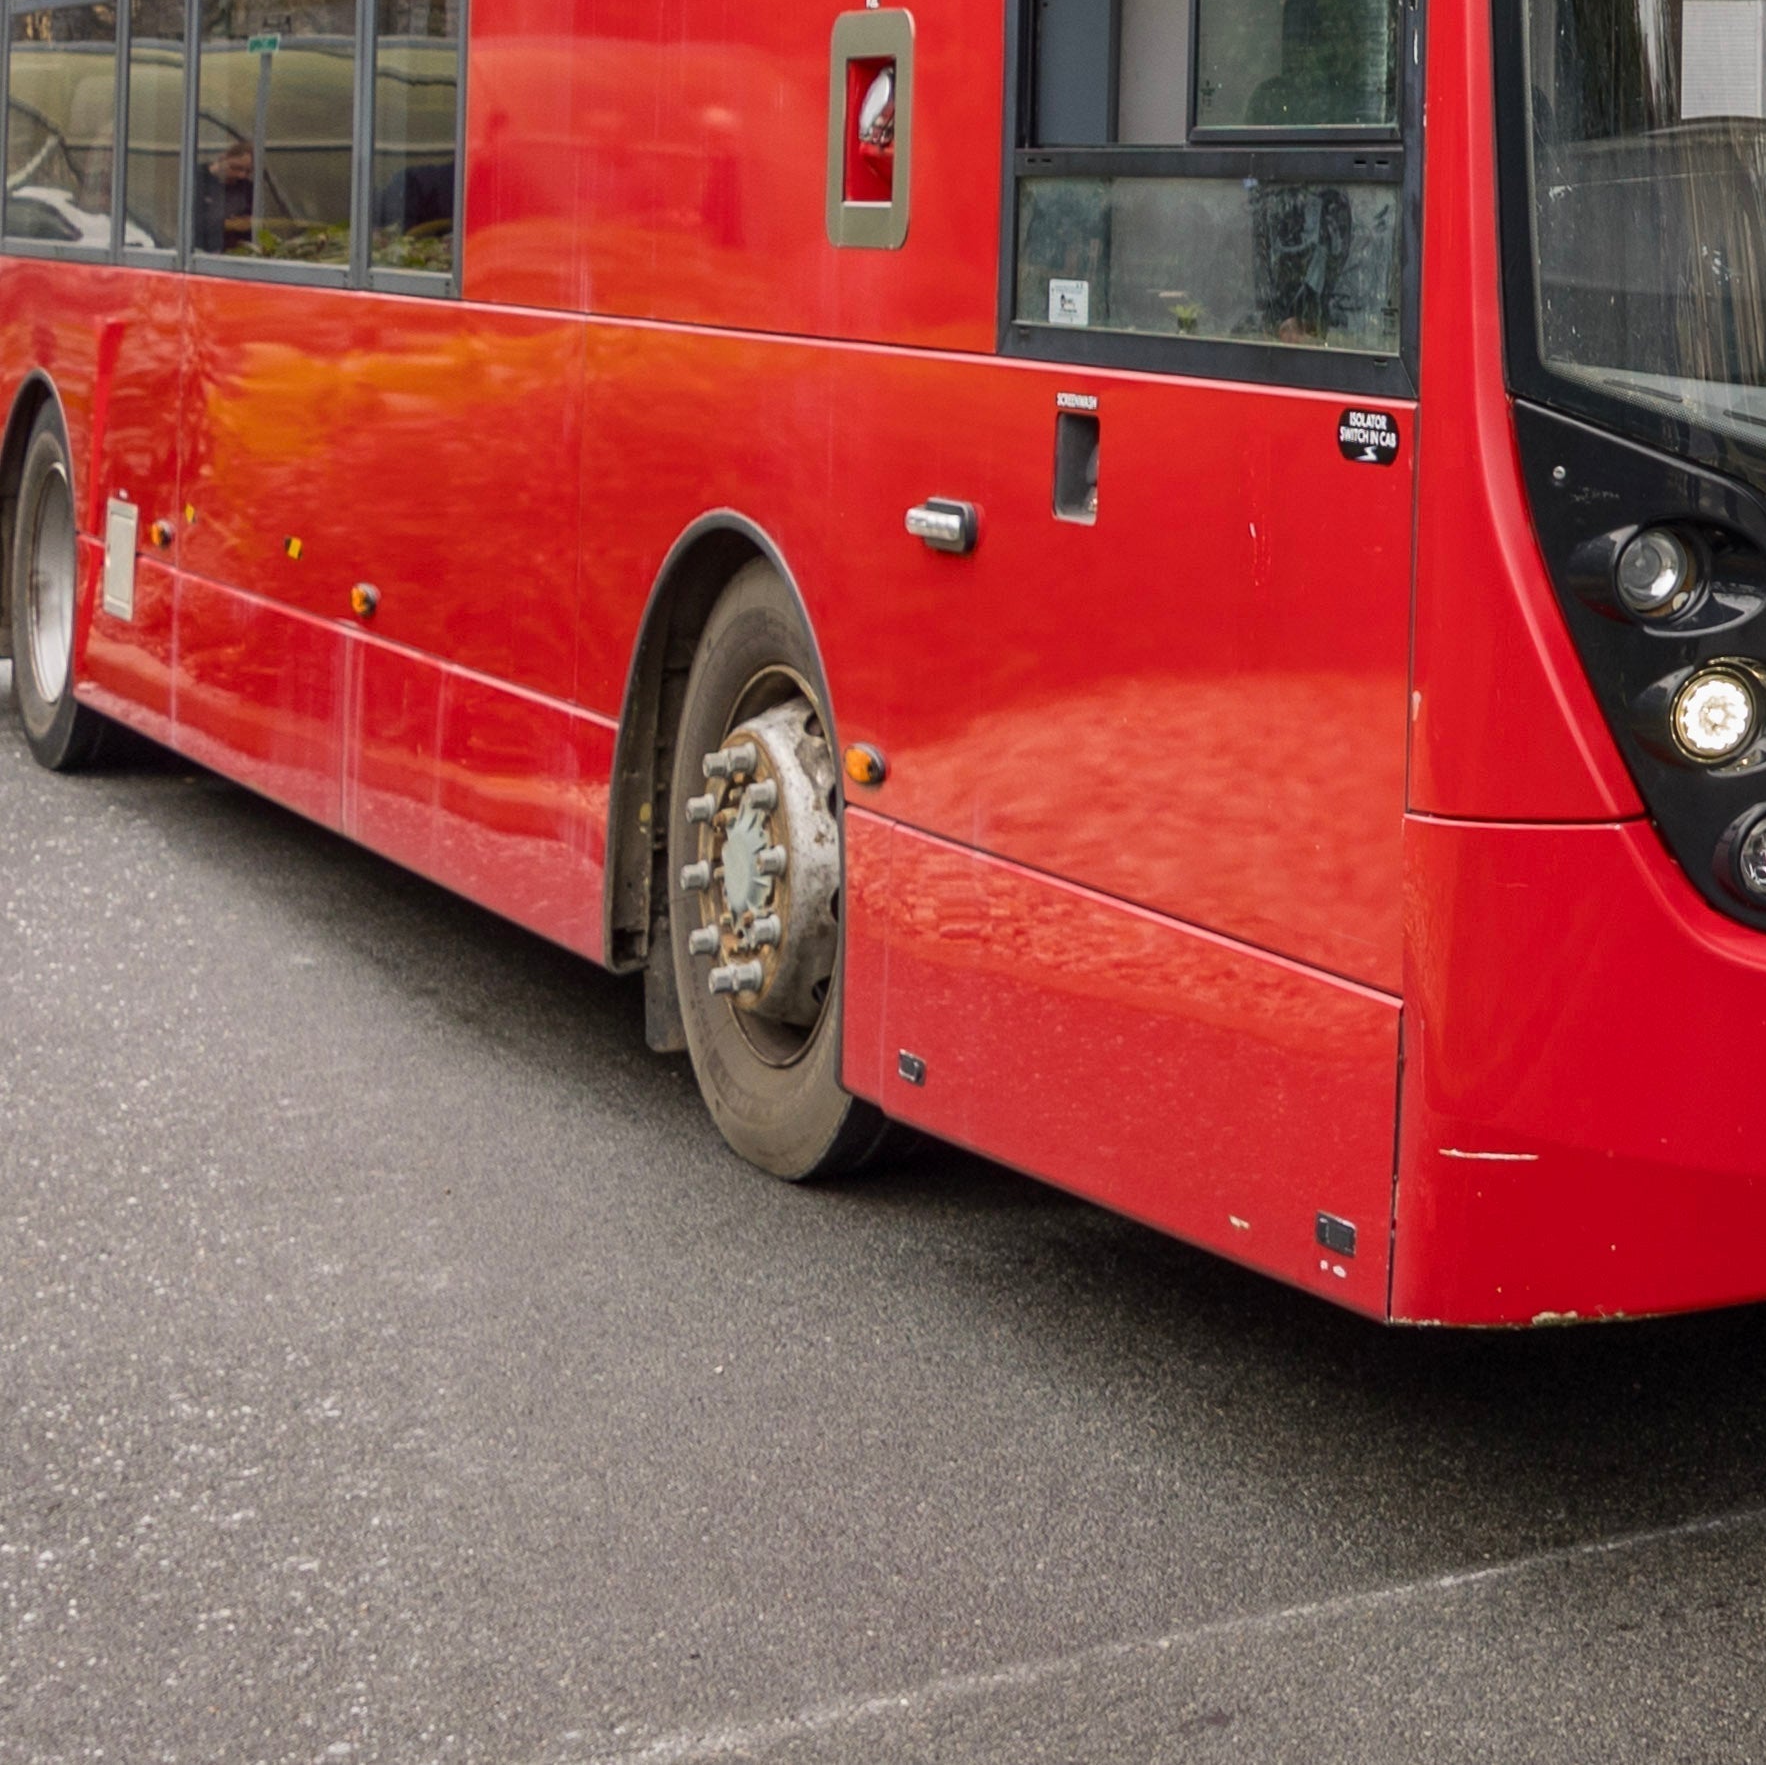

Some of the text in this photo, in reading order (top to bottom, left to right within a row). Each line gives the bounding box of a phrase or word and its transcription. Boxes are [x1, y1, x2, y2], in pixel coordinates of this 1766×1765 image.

[1349, 411, 1388, 431] ISOLATOR
[1340, 426, 1397, 449] SWITCH IN CAB
